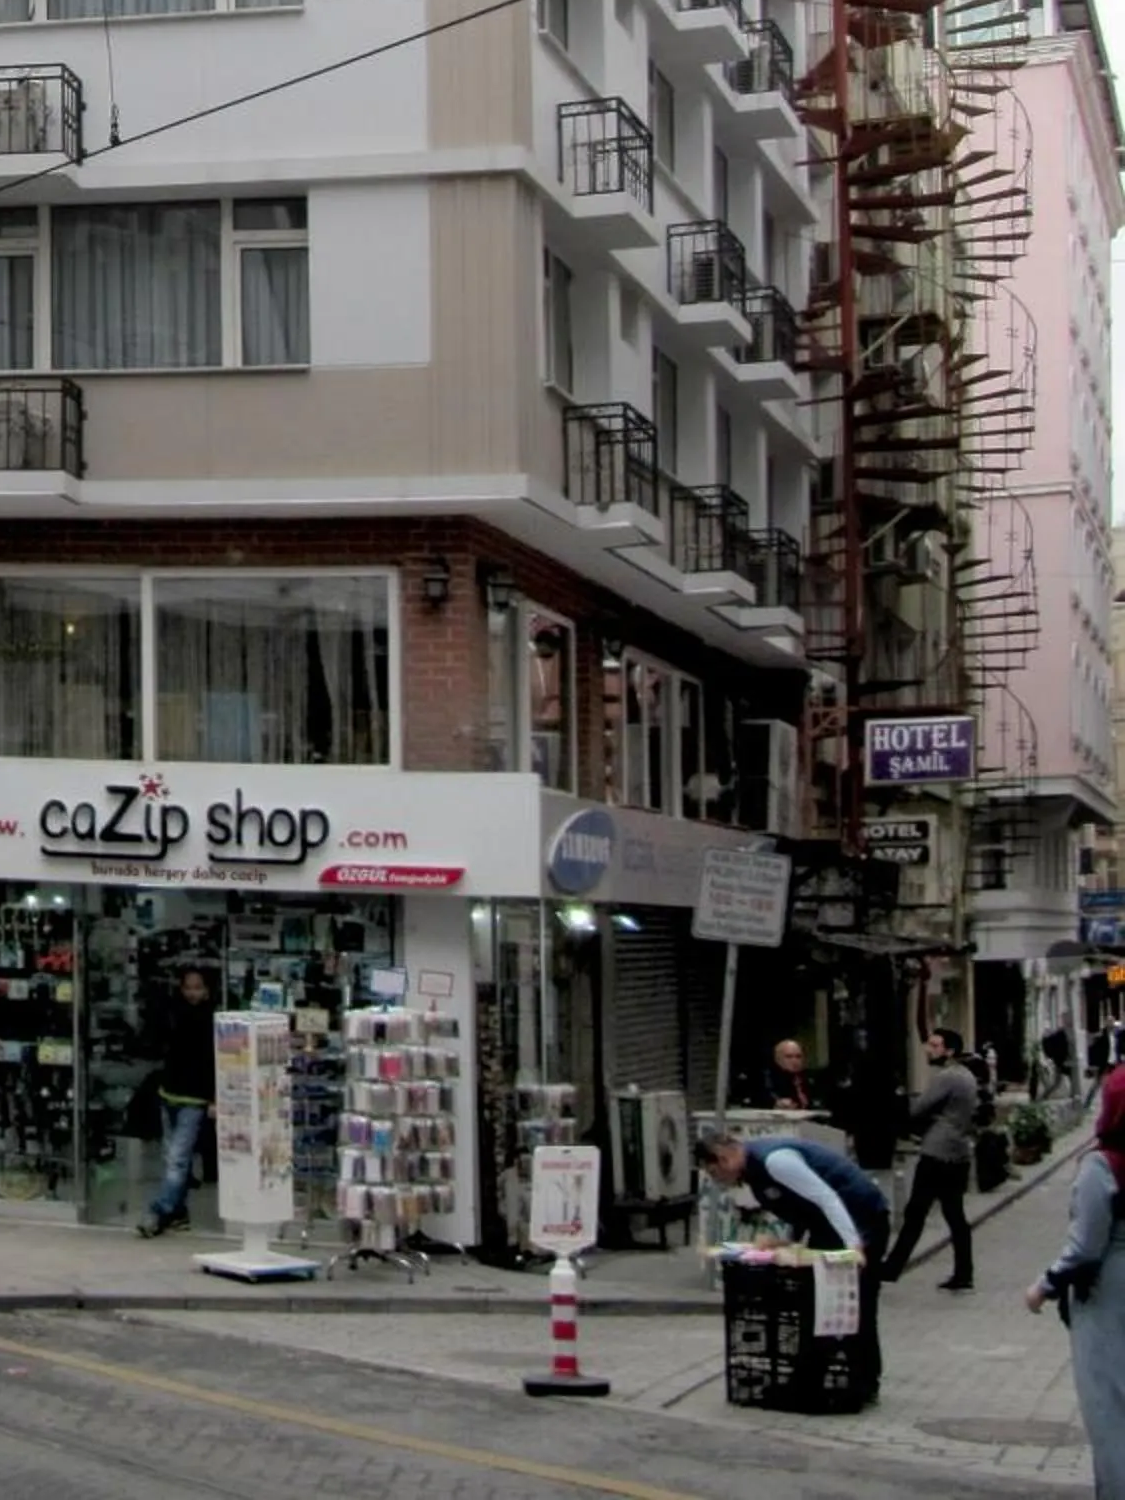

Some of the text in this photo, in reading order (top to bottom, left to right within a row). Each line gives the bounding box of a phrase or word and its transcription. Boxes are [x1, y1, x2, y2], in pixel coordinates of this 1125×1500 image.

[874, 724, 967, 751] HOTEL
[889, 751, 951, 779] ŞAMİL
[206, 787, 330, 865] shop
[338, 829, 408, 850] .com
